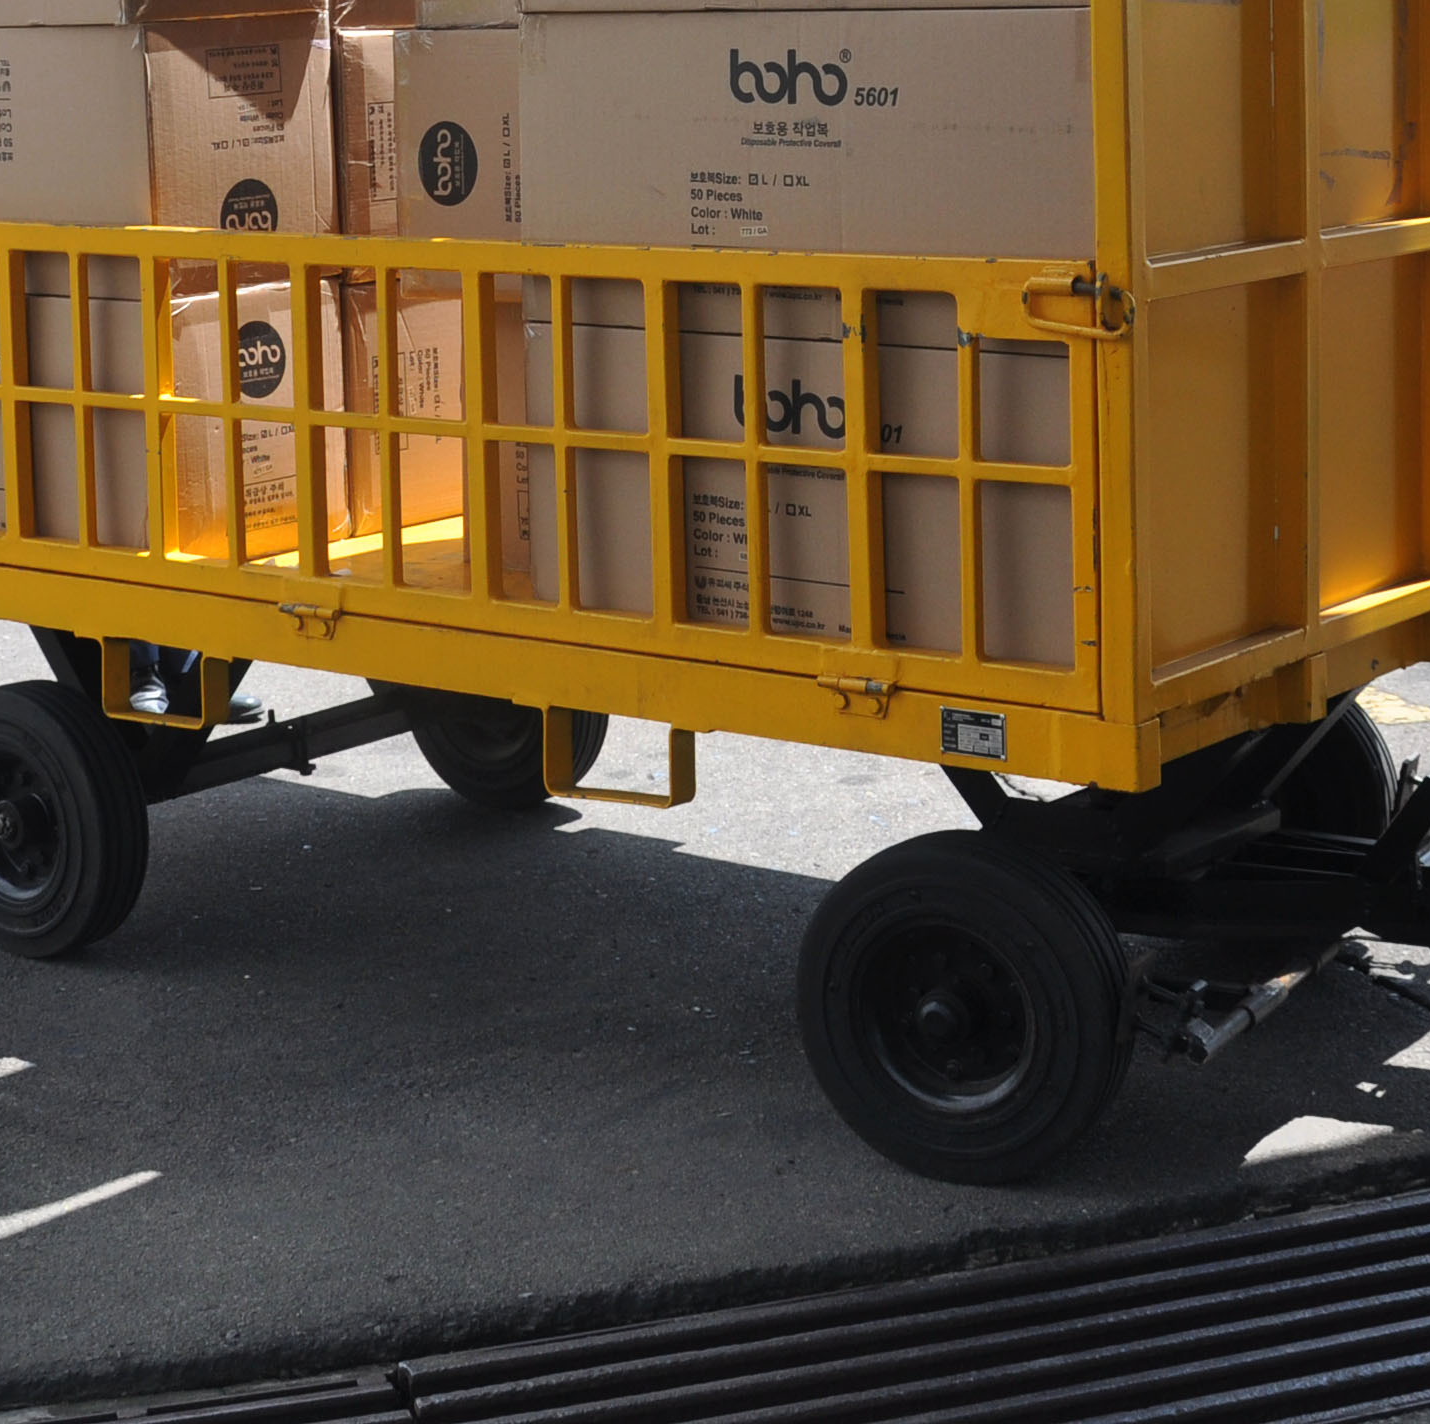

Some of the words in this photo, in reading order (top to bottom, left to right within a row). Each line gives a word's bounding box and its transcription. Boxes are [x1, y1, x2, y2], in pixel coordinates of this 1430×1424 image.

[854, 87, 899, 107] 5601
[752, 122, 789, 136] 보호용
[792, 122, 829, 137] 작업복
[741, 137, 777, 147] Disposable
[778, 138, 812, 147] Protective
[813, 139, 842, 149] Coverall
[795, 176, 810, 187] XL
[691, 189, 703, 201] 50
[706, 190, 743, 202] Pieces
[691, 207, 721, 218] Color
[730, 208, 763, 221] White
[798, 505, 812, 517] XL
[693, 511, 706, 523] 50
[709, 513, 745, 526] Pieces
[694, 529, 724, 543] Color
